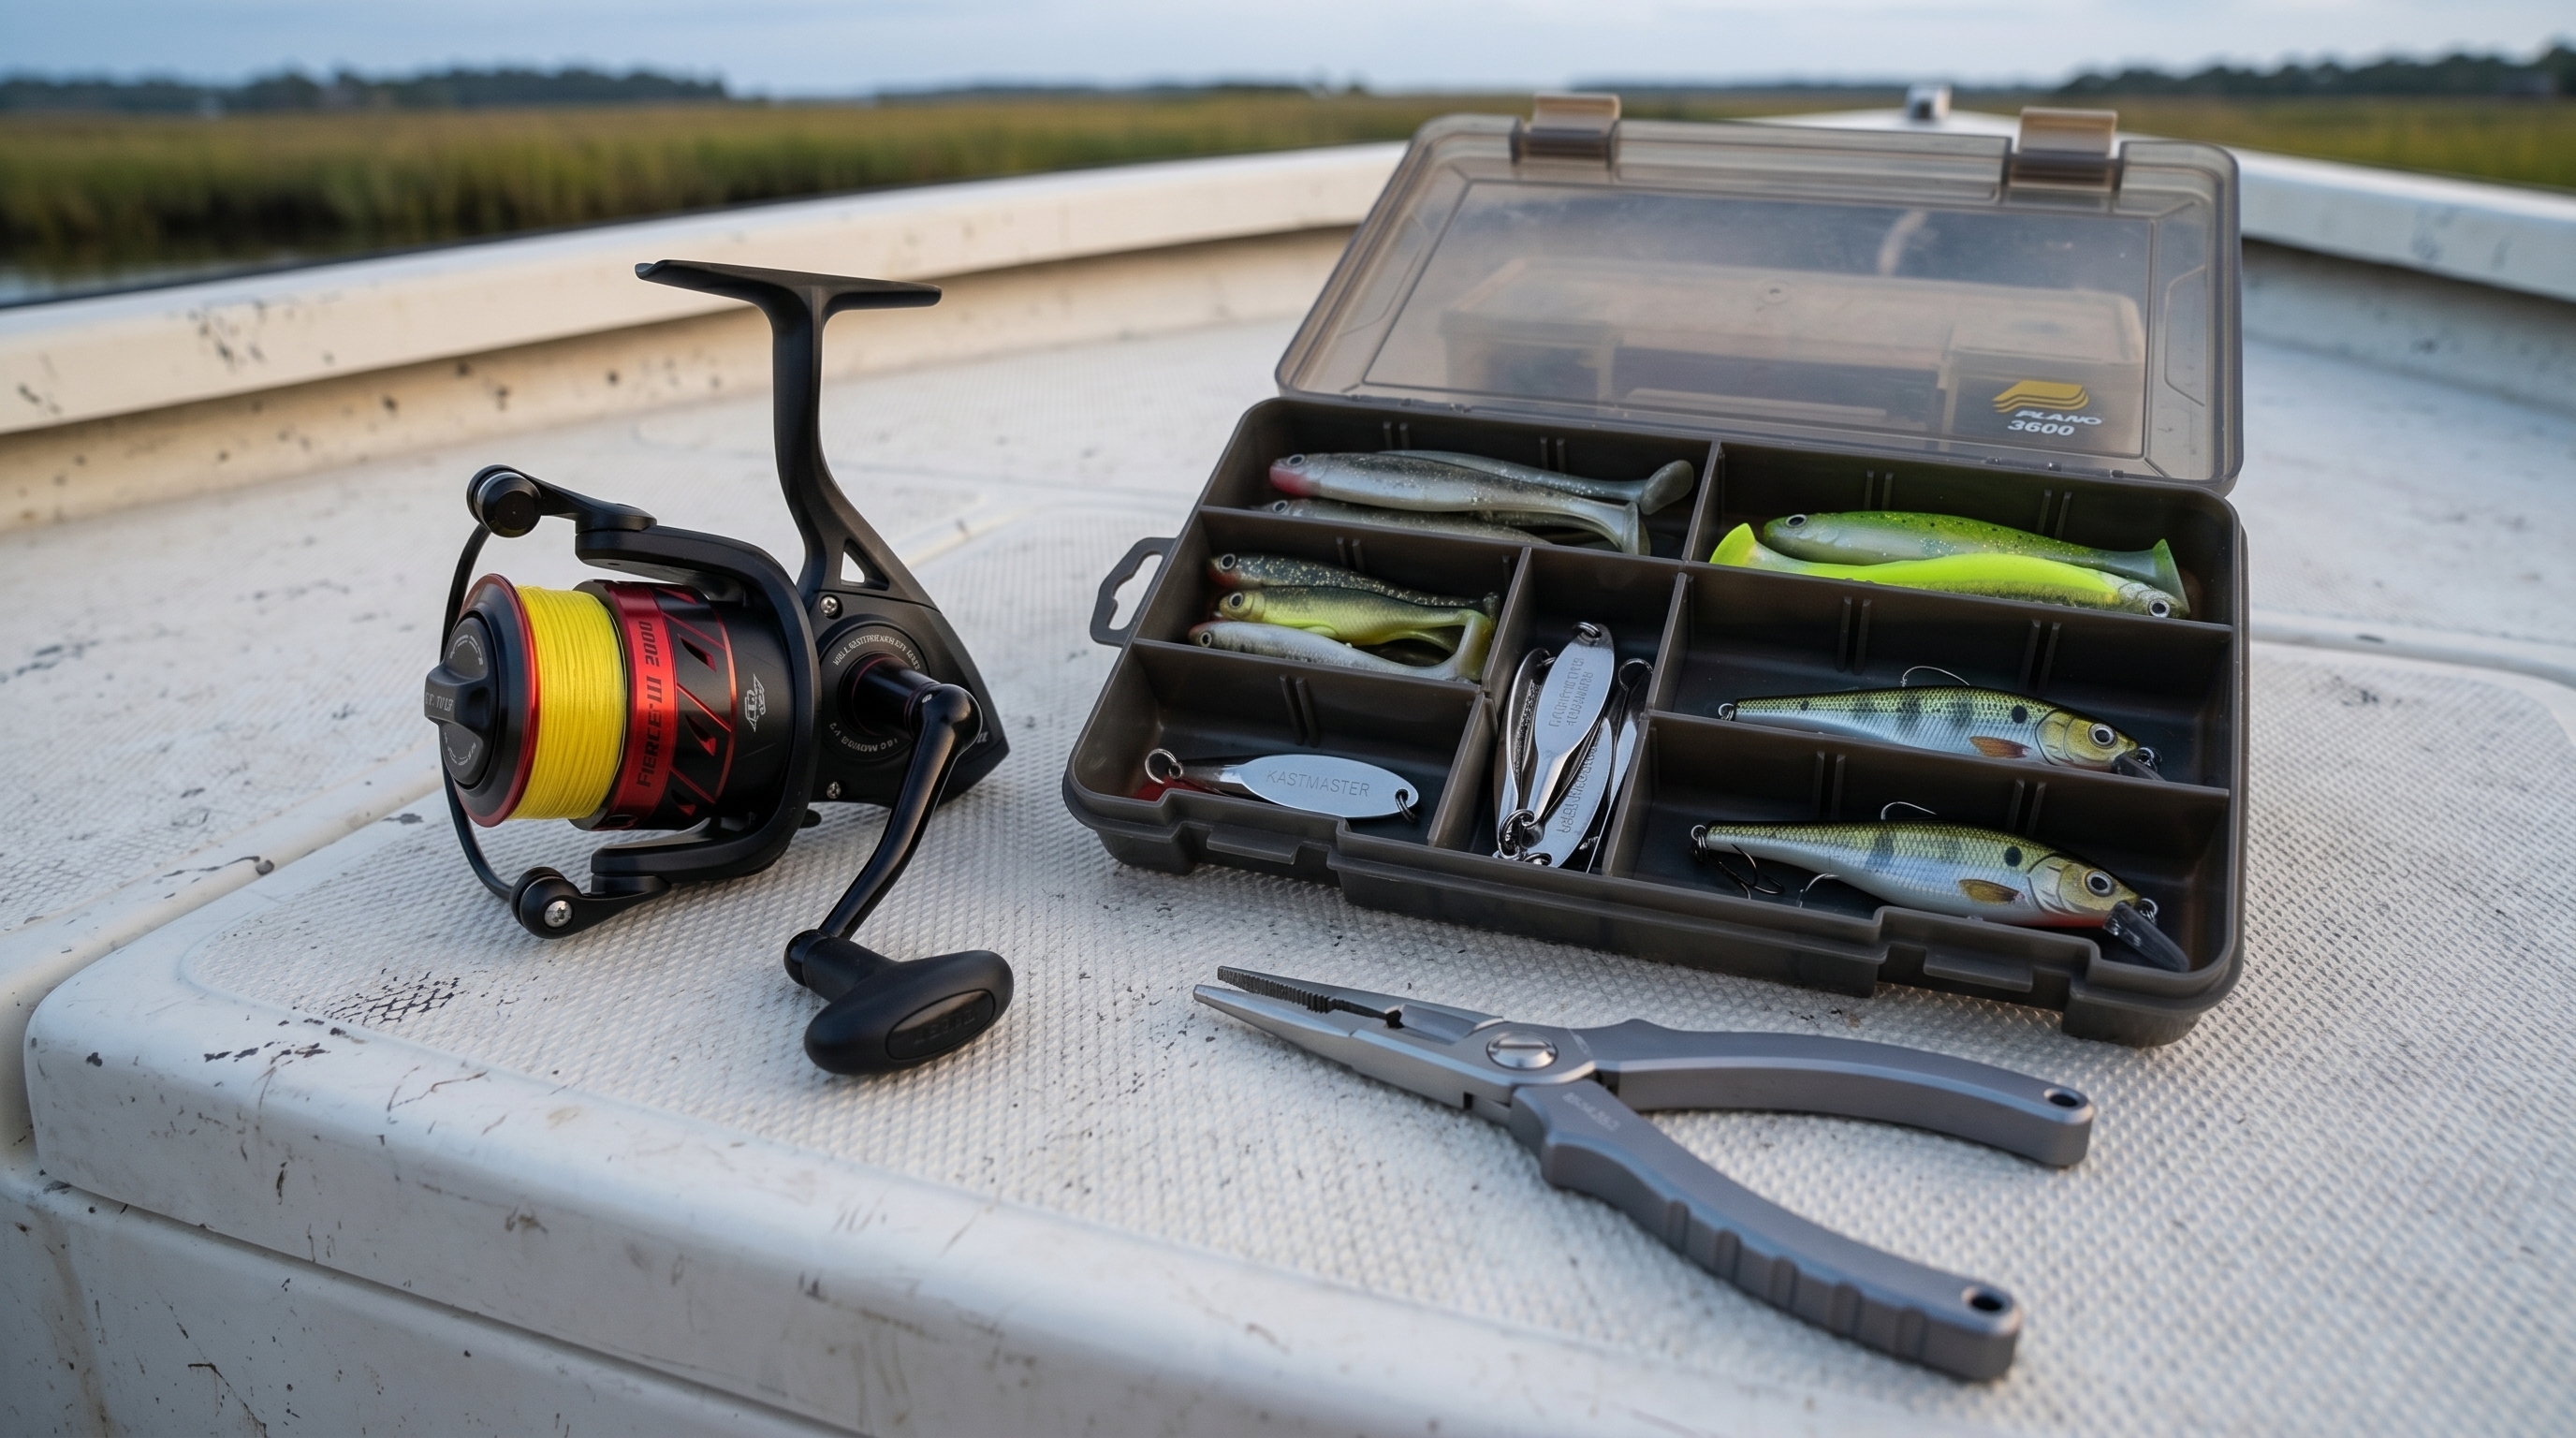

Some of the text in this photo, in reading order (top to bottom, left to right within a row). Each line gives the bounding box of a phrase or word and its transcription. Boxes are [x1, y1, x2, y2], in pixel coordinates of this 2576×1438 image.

[2007, 419, 2075, 436] 3600
[2015, 410, 2101, 425] PLANO
[638, 621, 660, 668] 2000
[1266, 770, 1370, 797] KASTMASTER
